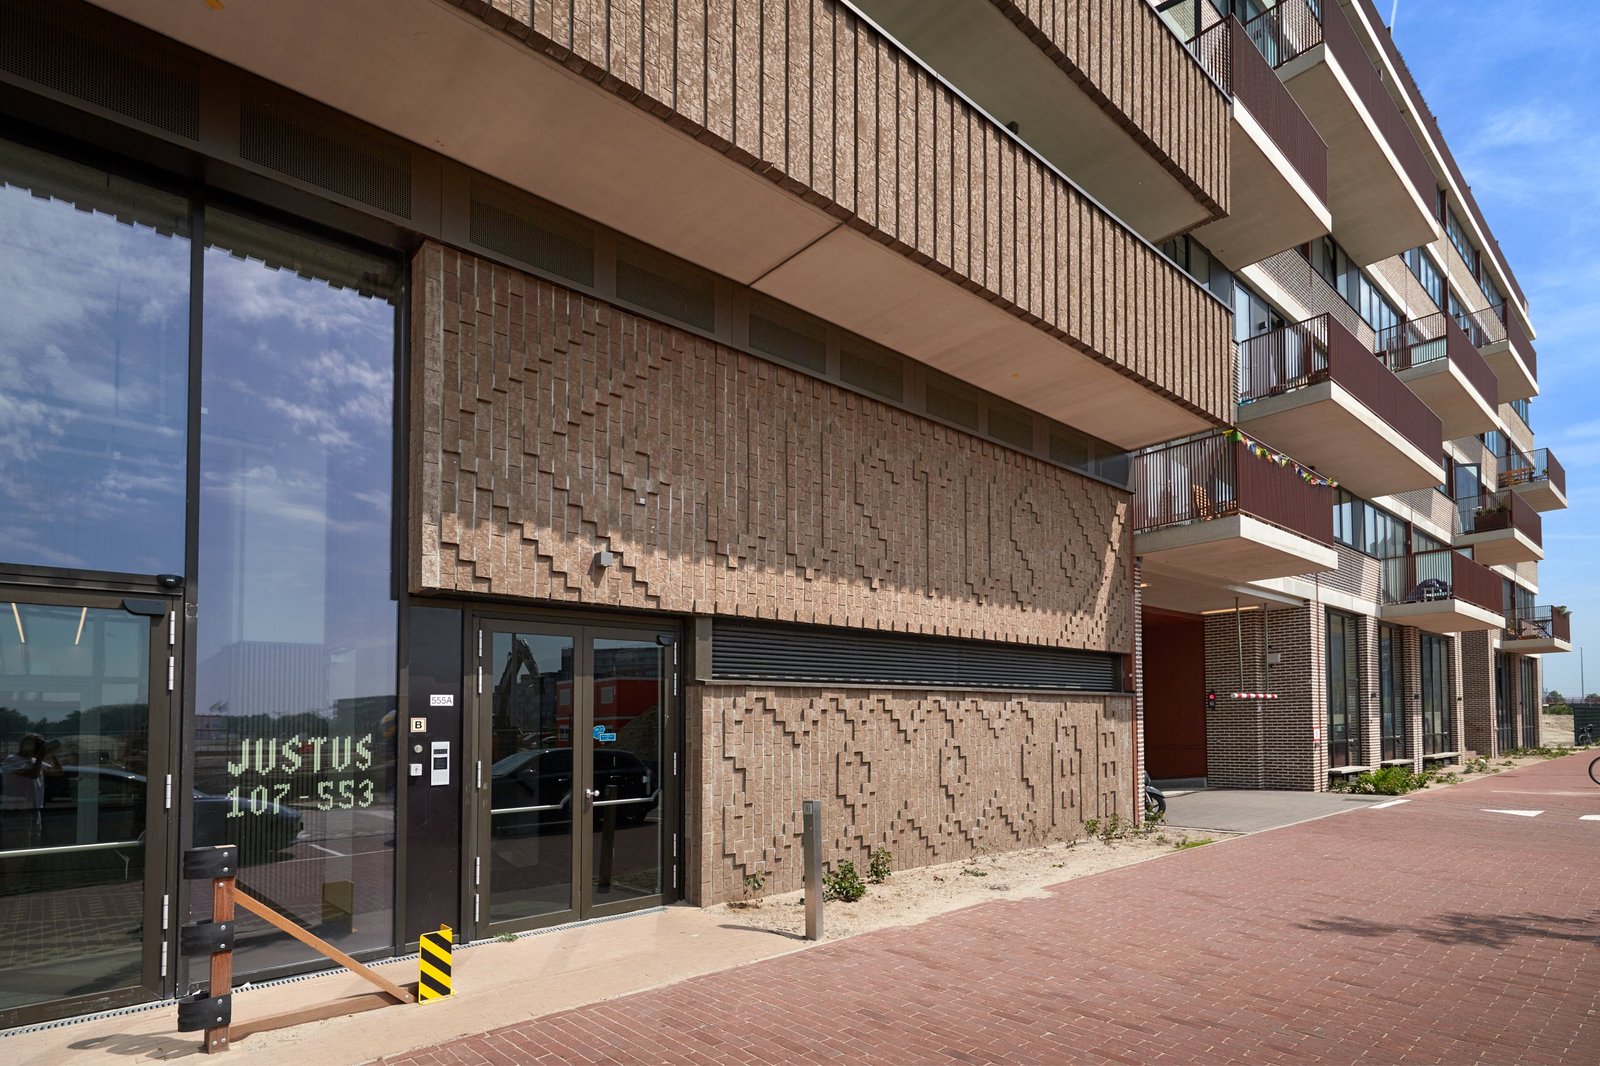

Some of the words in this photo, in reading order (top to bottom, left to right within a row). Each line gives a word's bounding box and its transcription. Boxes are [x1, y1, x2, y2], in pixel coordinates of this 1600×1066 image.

[431, 696, 453, 705] 555A
[414, 720, 423, 729] B
[227, 733, 372, 777] JUSTUS
